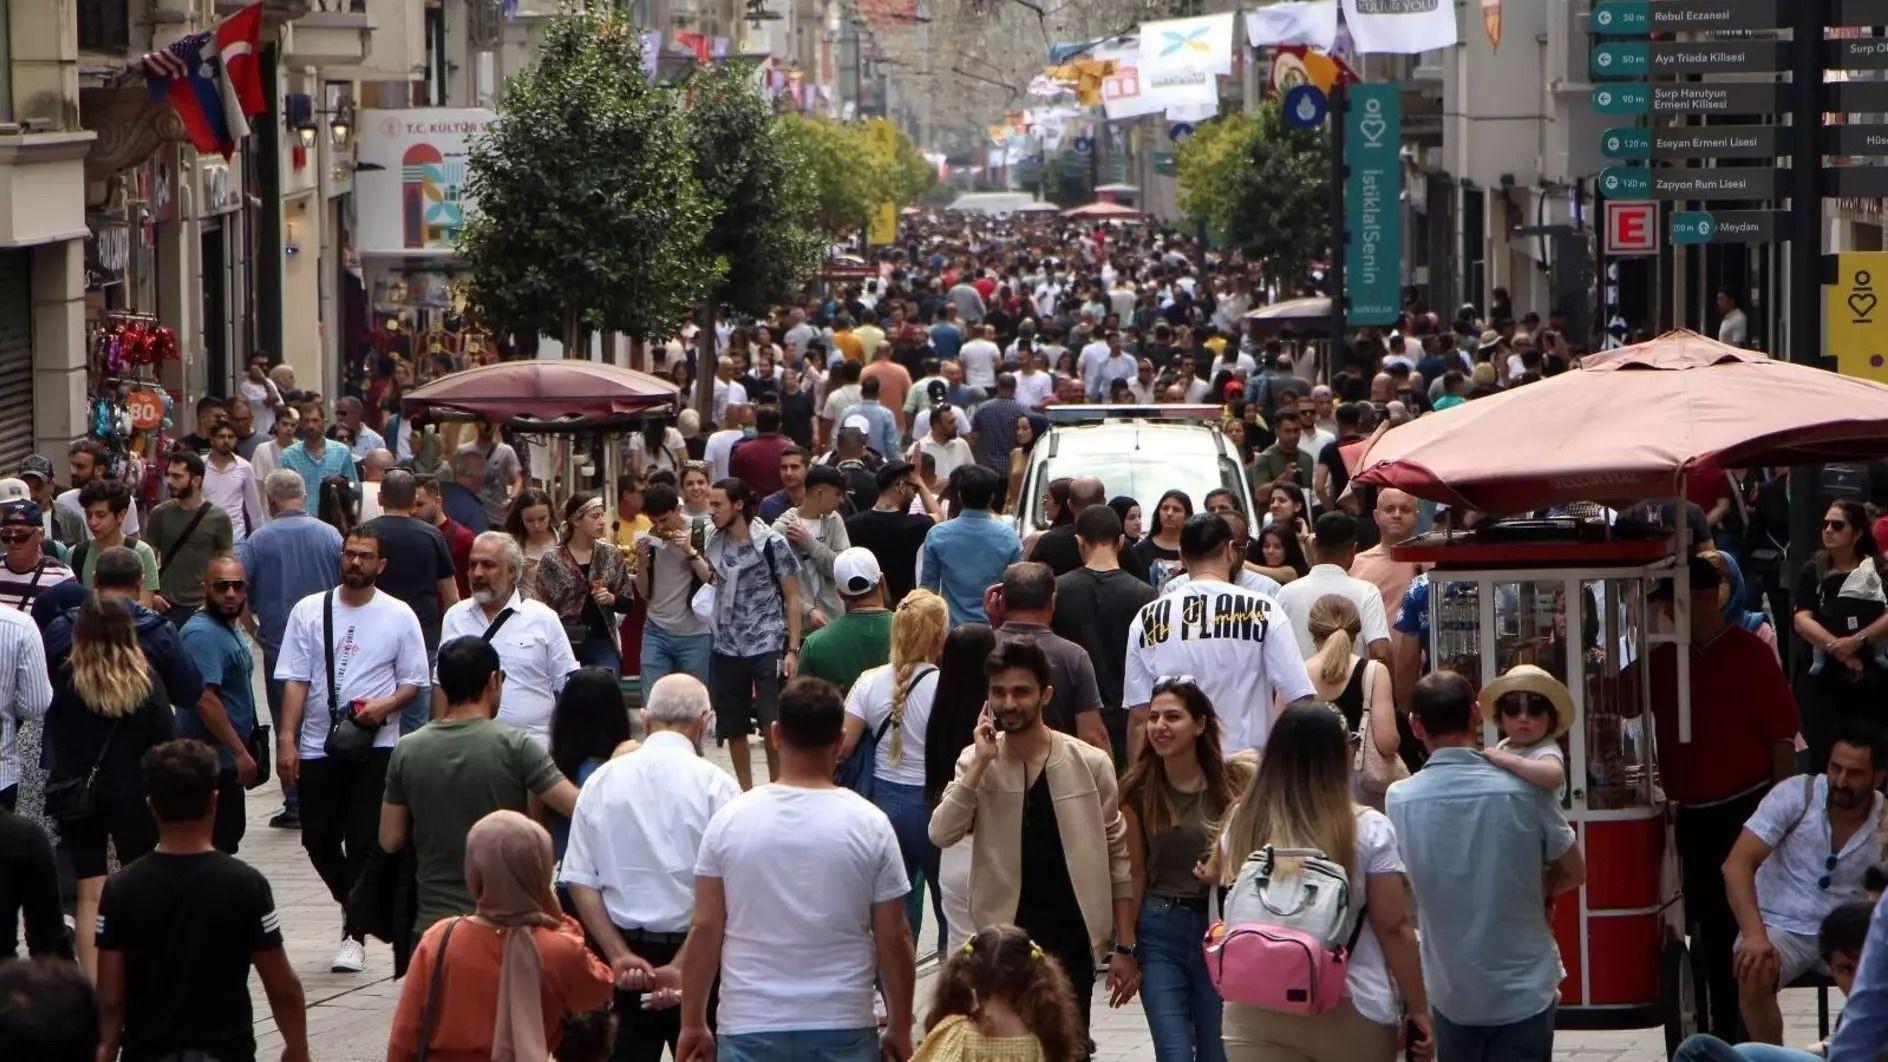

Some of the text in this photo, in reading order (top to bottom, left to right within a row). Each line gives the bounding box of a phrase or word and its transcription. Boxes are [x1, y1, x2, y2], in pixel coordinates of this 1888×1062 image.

[1654, 9, 1730, 21] Rebul Eczanesi
[1850, 43, 1874, 55] Surp
[1655, 52, 1745, 65] Aya Triada Kilisesi
[1622, 95, 1633, 103] 90
[1654, 88, 1727, 100] Surp Harutyun
[1654, 100, 1727, 110] Ermeni Kilisesi
[1624, 139, 1639, 148] 120
[1692, 138, 1728, 148] Ermeni
[1730, 137, 1757, 147] Lisesi
[1622, 179, 1638, 188] 120
[1656, 179, 1746, 191] Zapyon Rum Lisesi
[1618, 211, 1646, 243] E
[130, 403, 155, 421] 80
[1139, 593, 1271, 648] NO PLANS
